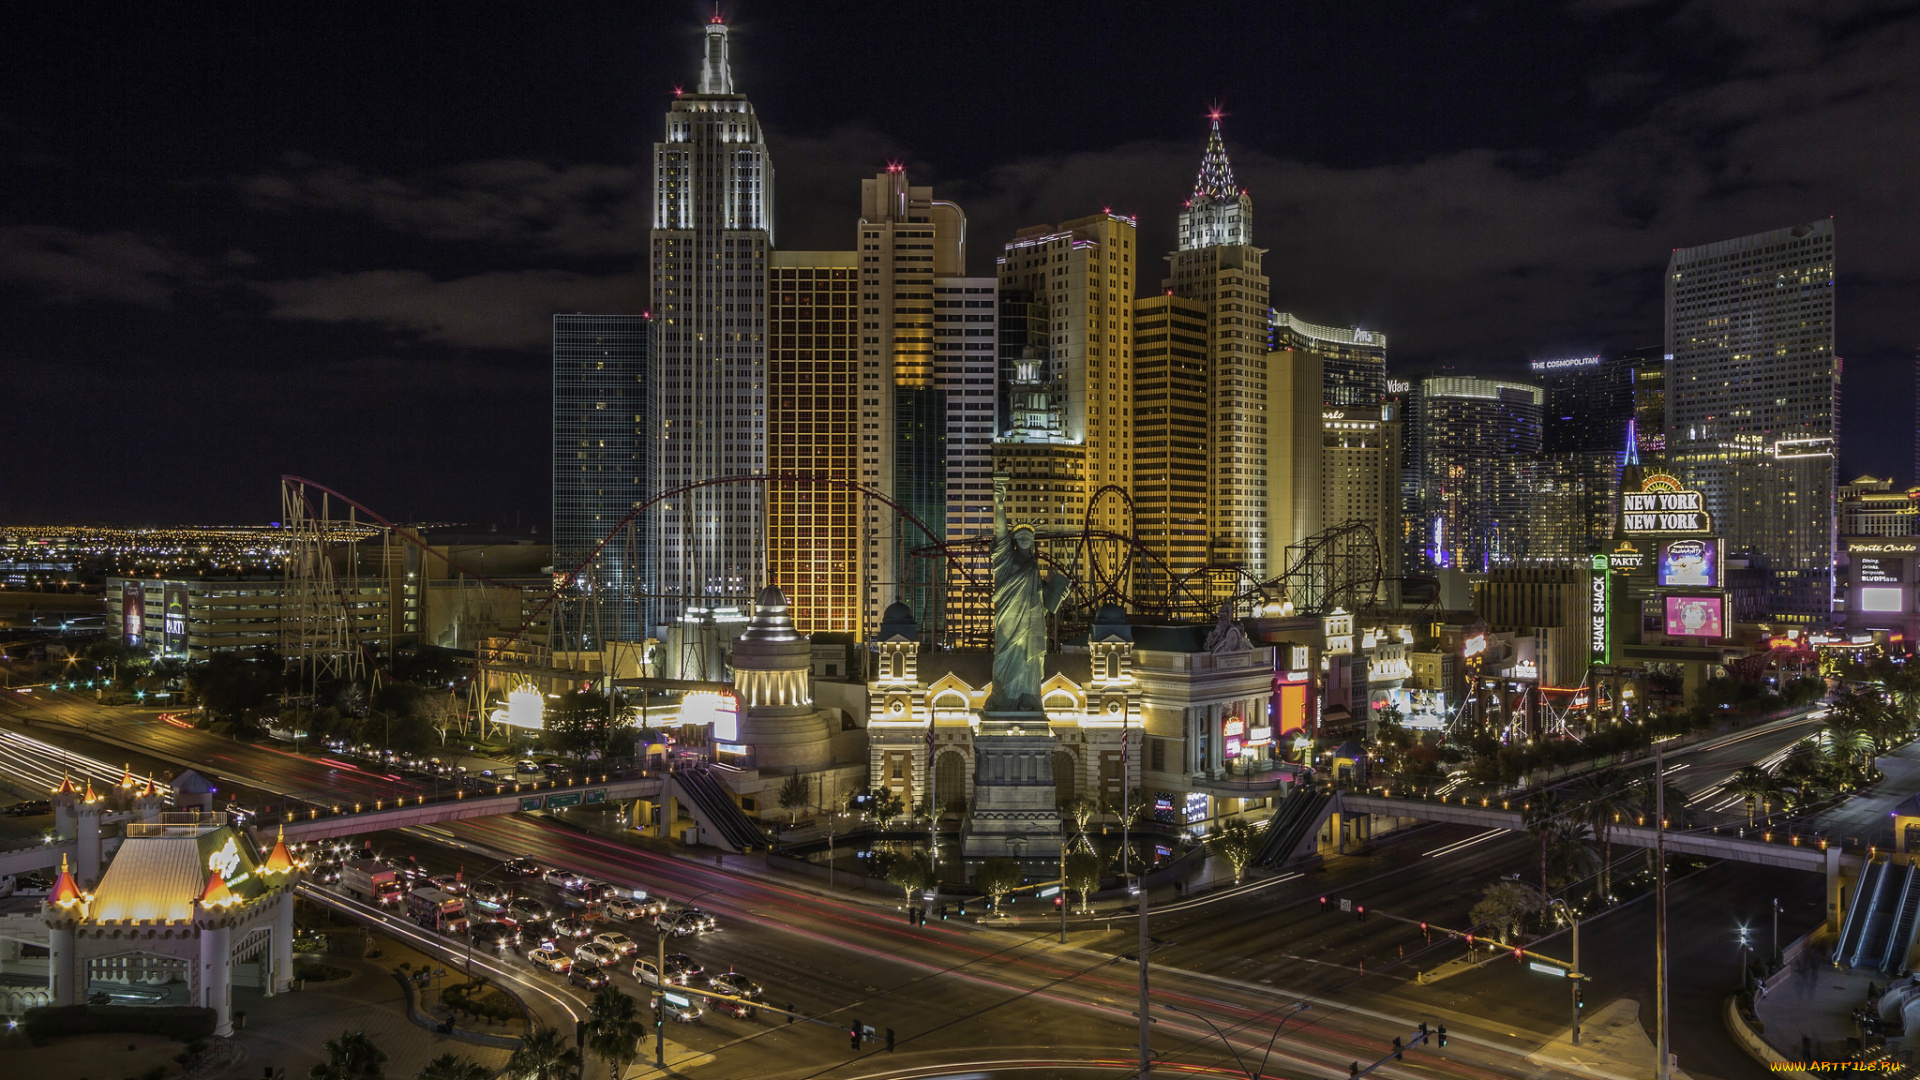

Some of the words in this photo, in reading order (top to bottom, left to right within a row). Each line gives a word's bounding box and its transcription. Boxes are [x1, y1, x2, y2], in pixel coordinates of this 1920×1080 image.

[1546, 357, 1598, 368] COSMOPOLITAN
[1387, 380, 1409, 393] Vdara
[1322, 410, 1344, 419] arlo
[1624, 495, 1656, 511] NEW
[1659, 494, 1698, 510] YORK
[1624, 514, 1656, 530] NEW
[1659, 513, 1698, 530] YORK
[1848, 544, 1882, 553] Monte
[1883, 544, 1917, 553] Carlo
[1611, 558, 1643, 566] PARTY.
[1593, 576, 1604, 613] SHACK
[1593, 616, 1604, 652] SHAKE
